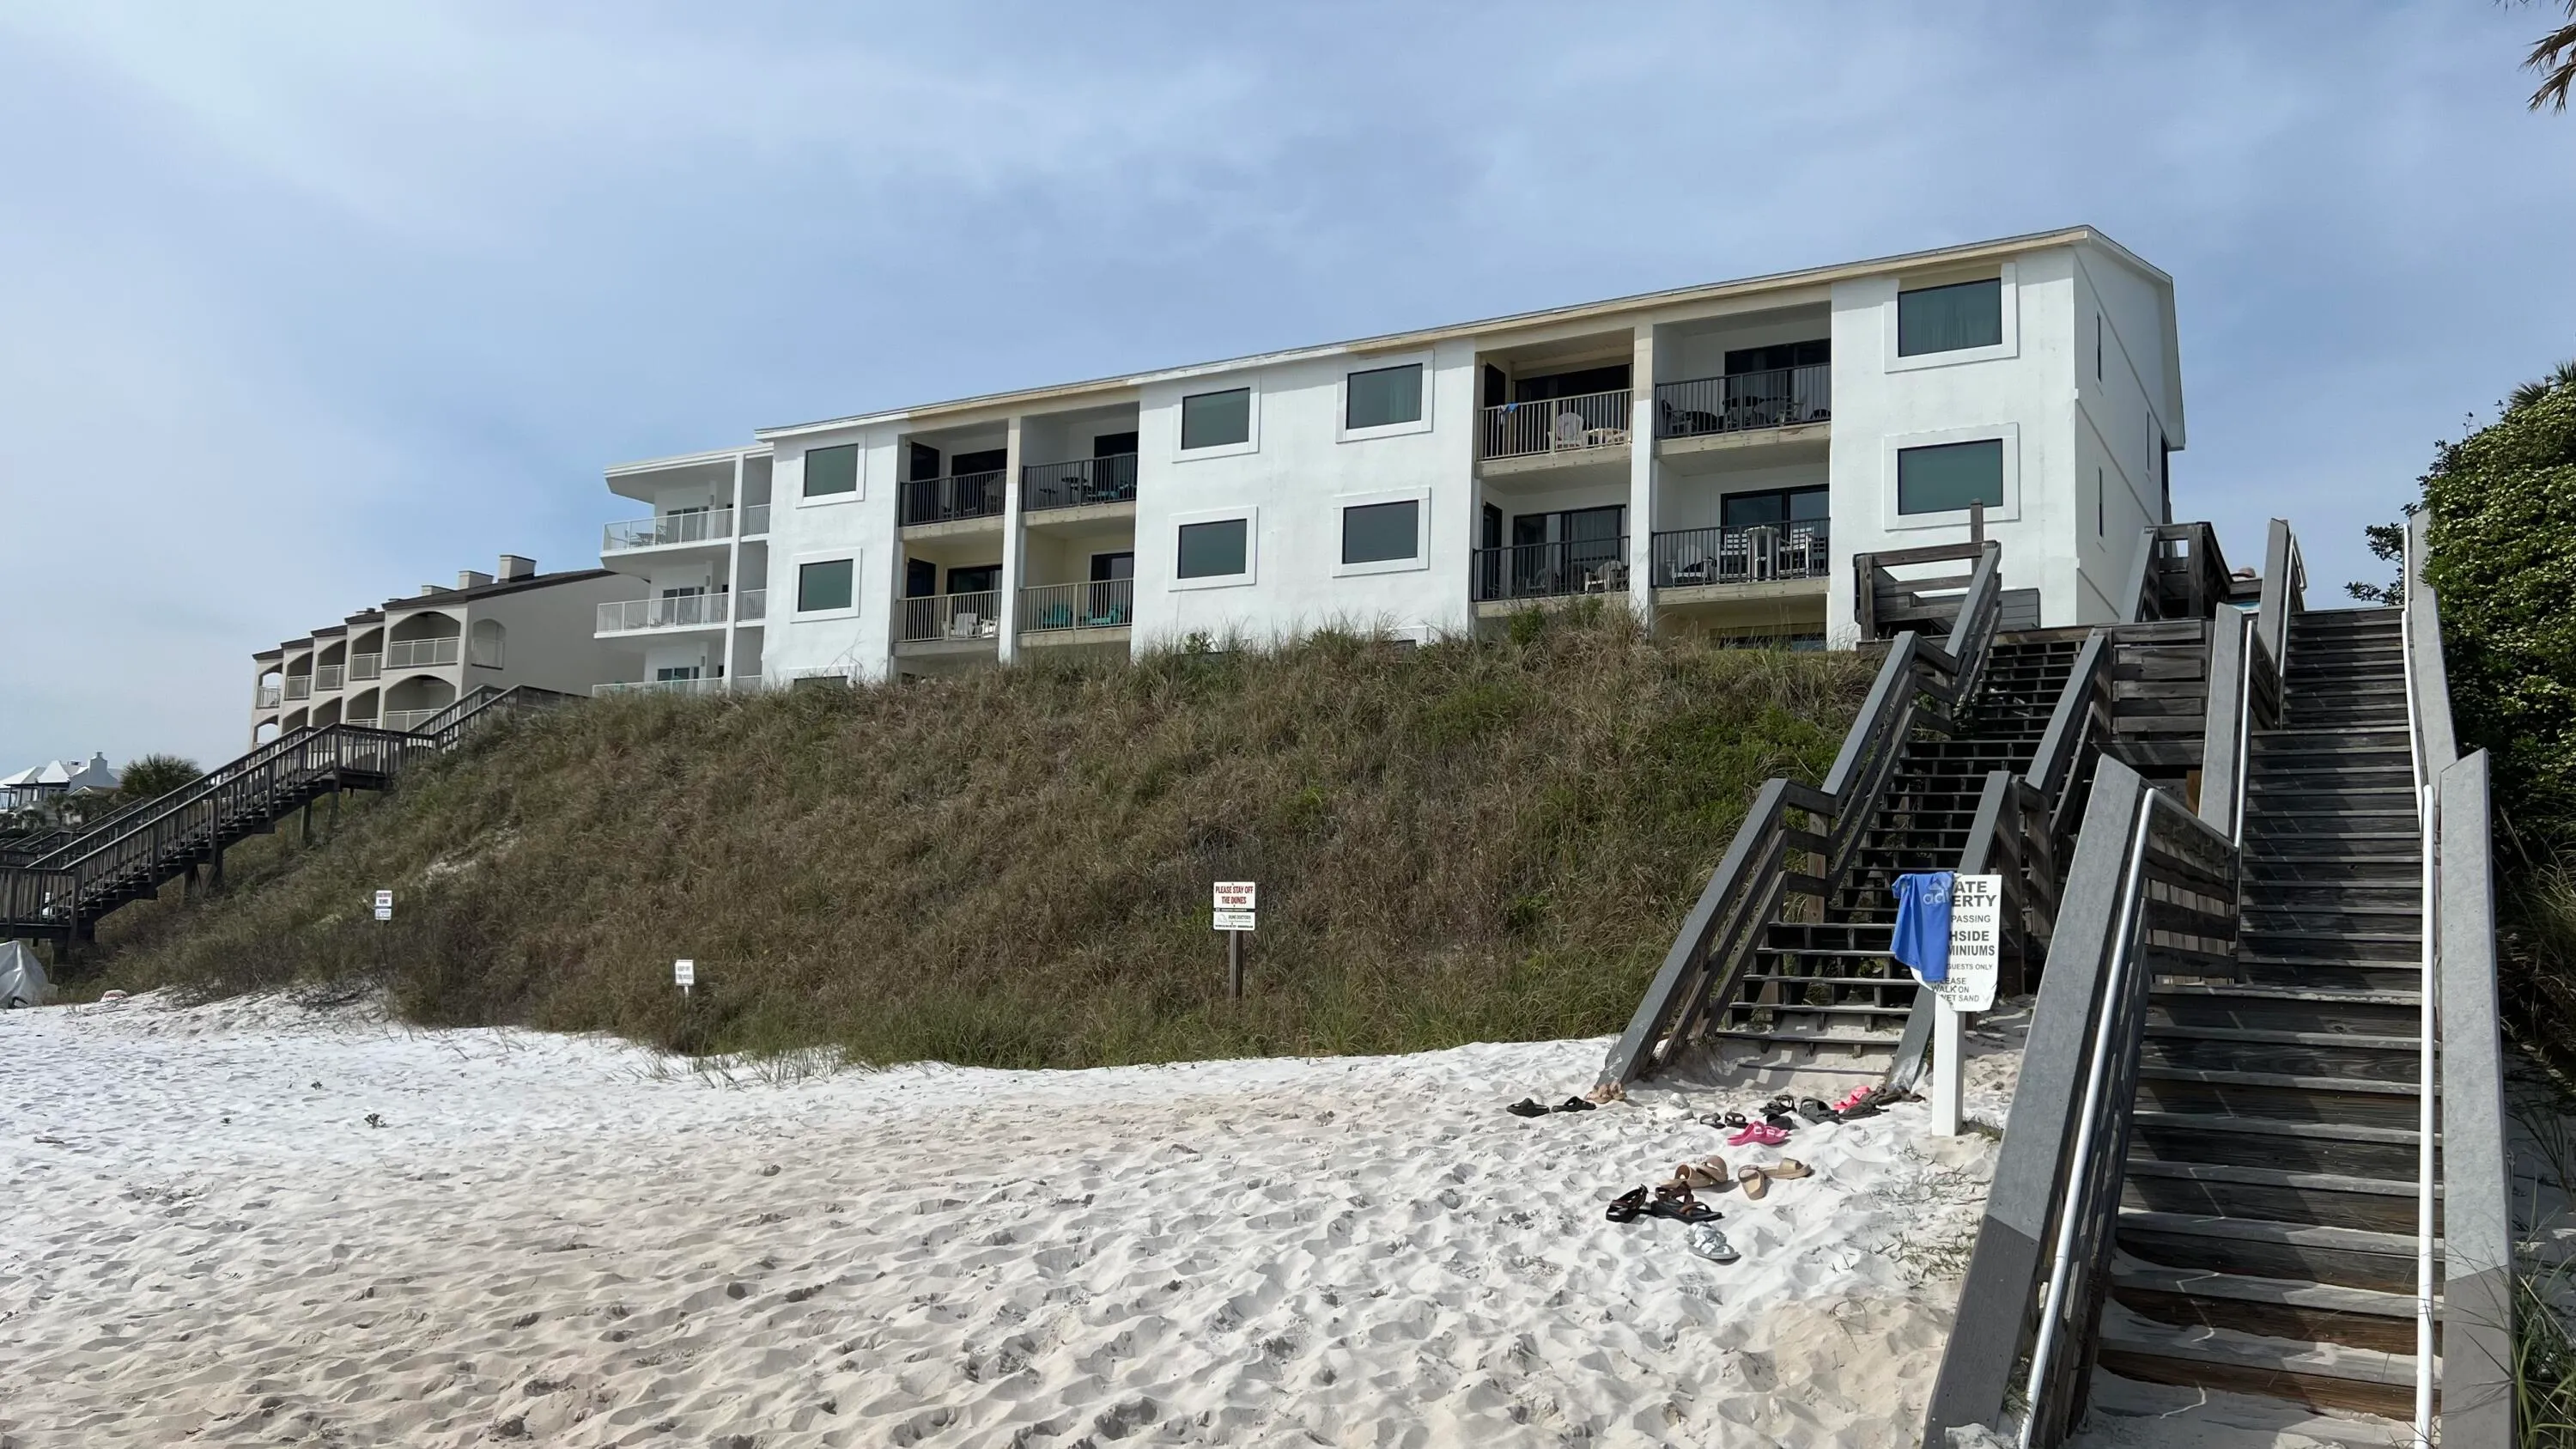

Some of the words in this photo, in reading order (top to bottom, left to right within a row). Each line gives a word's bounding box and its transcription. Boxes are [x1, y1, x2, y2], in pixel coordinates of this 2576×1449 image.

[1215, 886, 1232, 894] PLEASE
[1233, 886, 1244, 894] STAY
[1244, 886, 1254, 894] OFF
[1953, 881, 1988, 893] ATE
[1221, 896, 1230, 904] THE
[1230, 896, 1247, 904] DUNES
[1923, 889, 1950, 905] adi
[1952, 894, 1997, 907] ERTY
[1951, 915, 1991, 923] PASSING
[1949, 930, 1990, 941] HSIDE
[1947, 945, 1996, 956] MINIUMS
[1931, 984, 1957, 994] WALK
[1958, 985, 1970, 994] ON
[1958, 994, 1980, 1002] SAND
